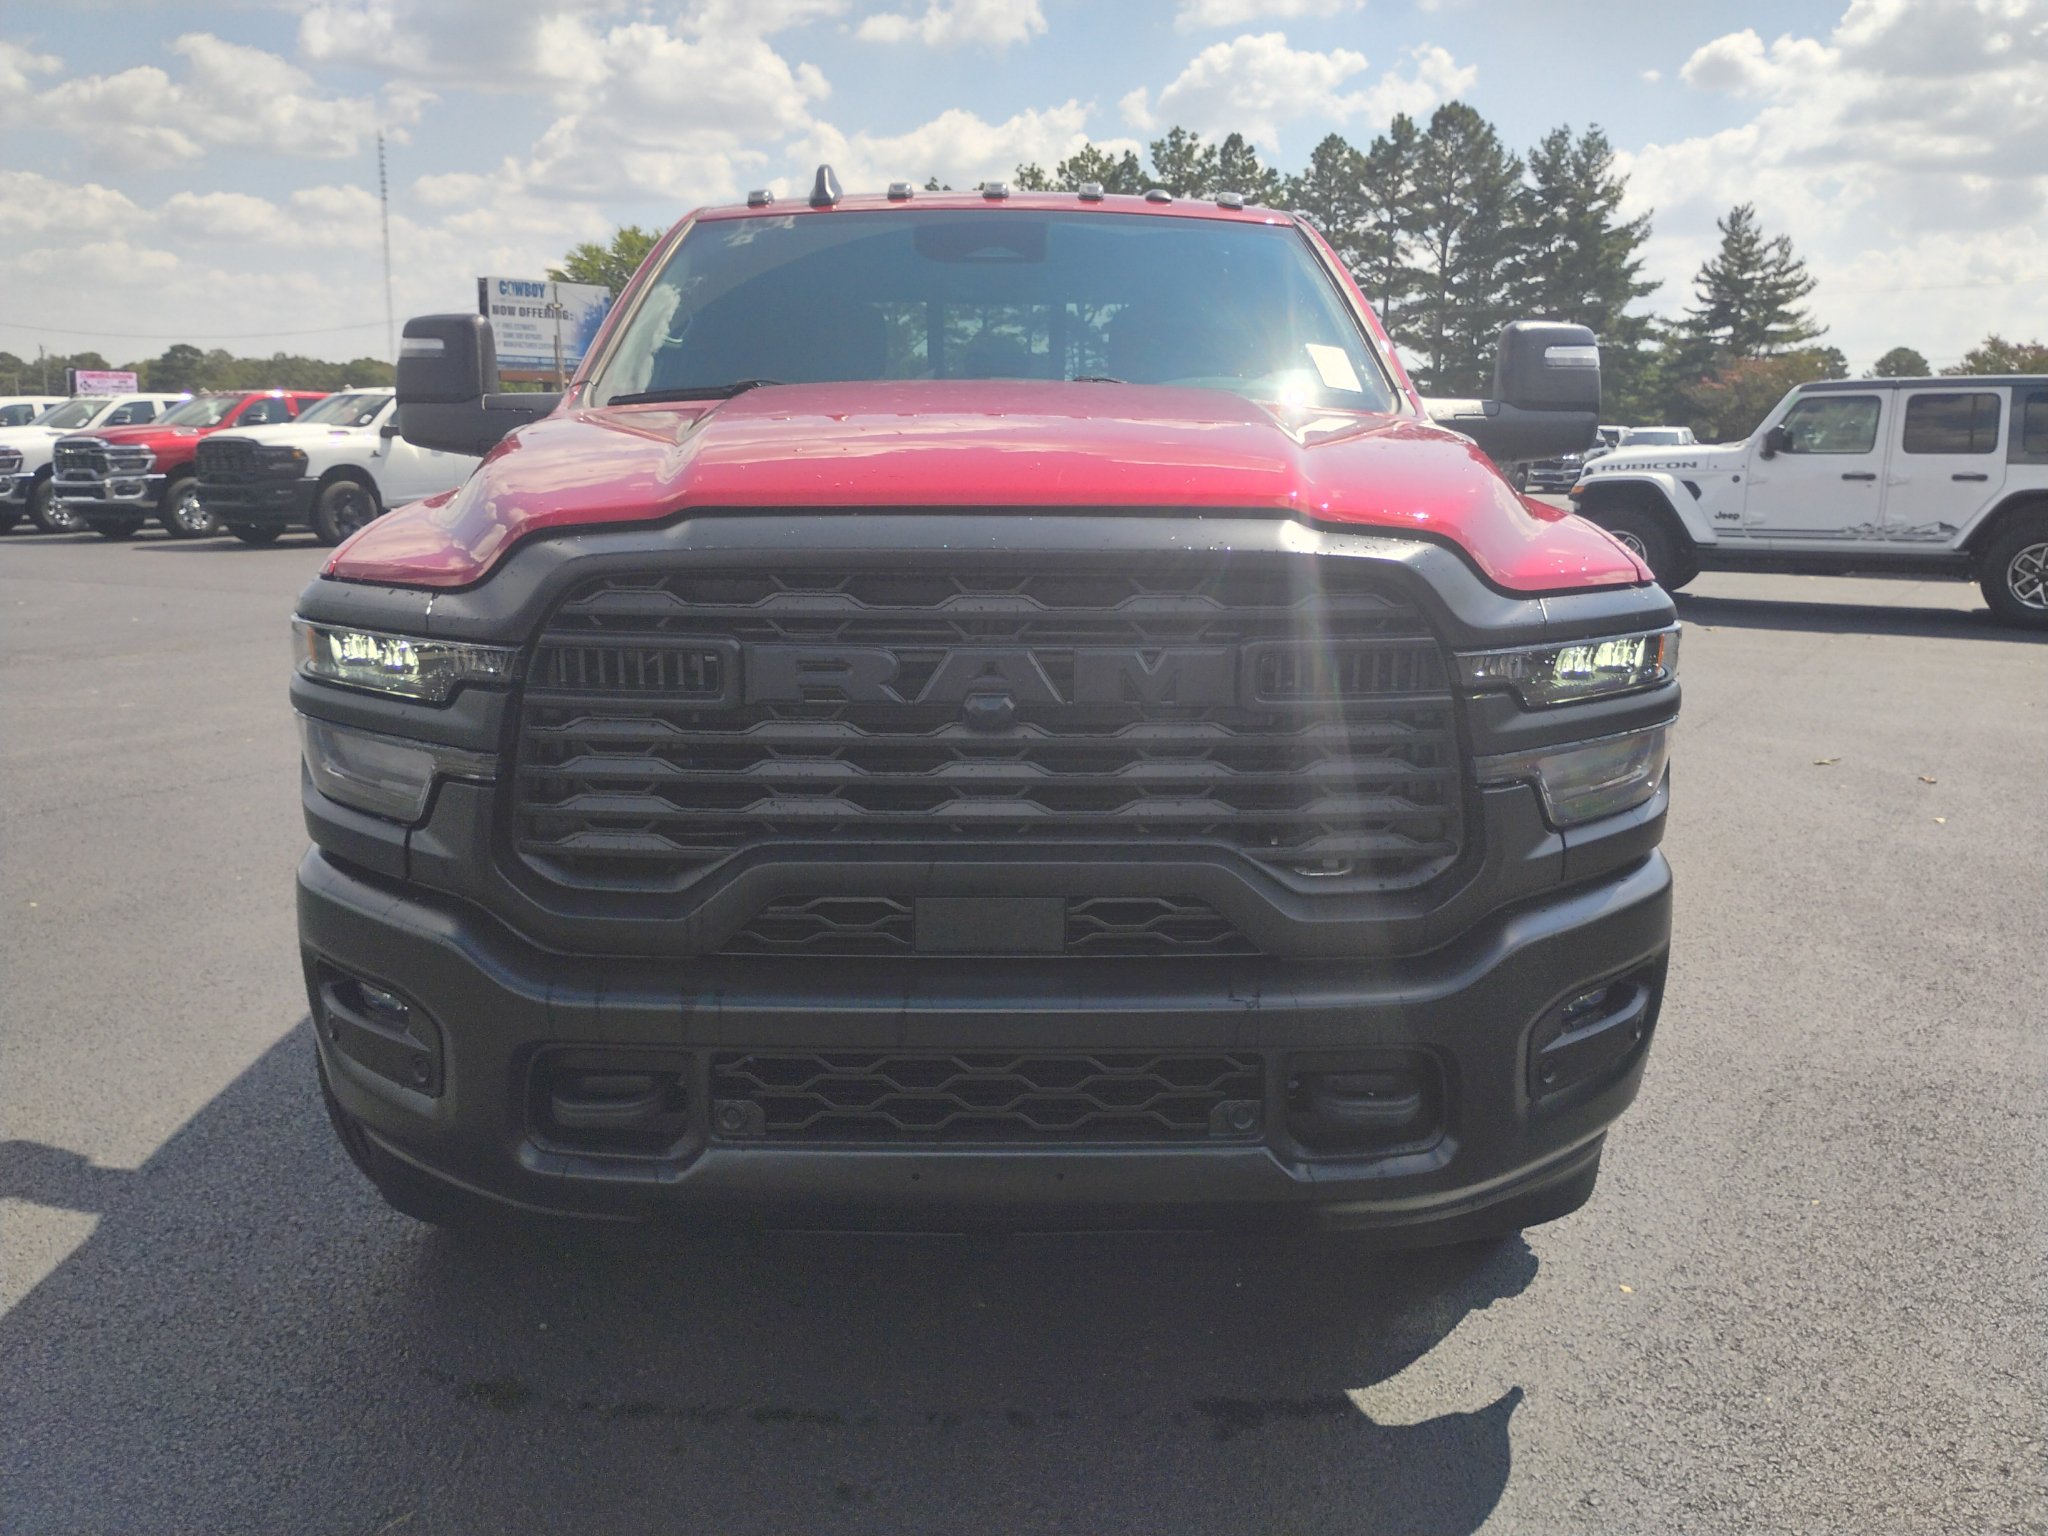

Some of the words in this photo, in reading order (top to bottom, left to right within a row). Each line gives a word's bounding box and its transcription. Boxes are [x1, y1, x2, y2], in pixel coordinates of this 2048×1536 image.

[498, 280, 546, 298] COWBOY
[492, 304, 516, 317] NOW
[1601, 461, 1698, 471] RUBICON
[1714, 511, 1740, 521] Jeep
[747, 645, 1229, 704] RAM
